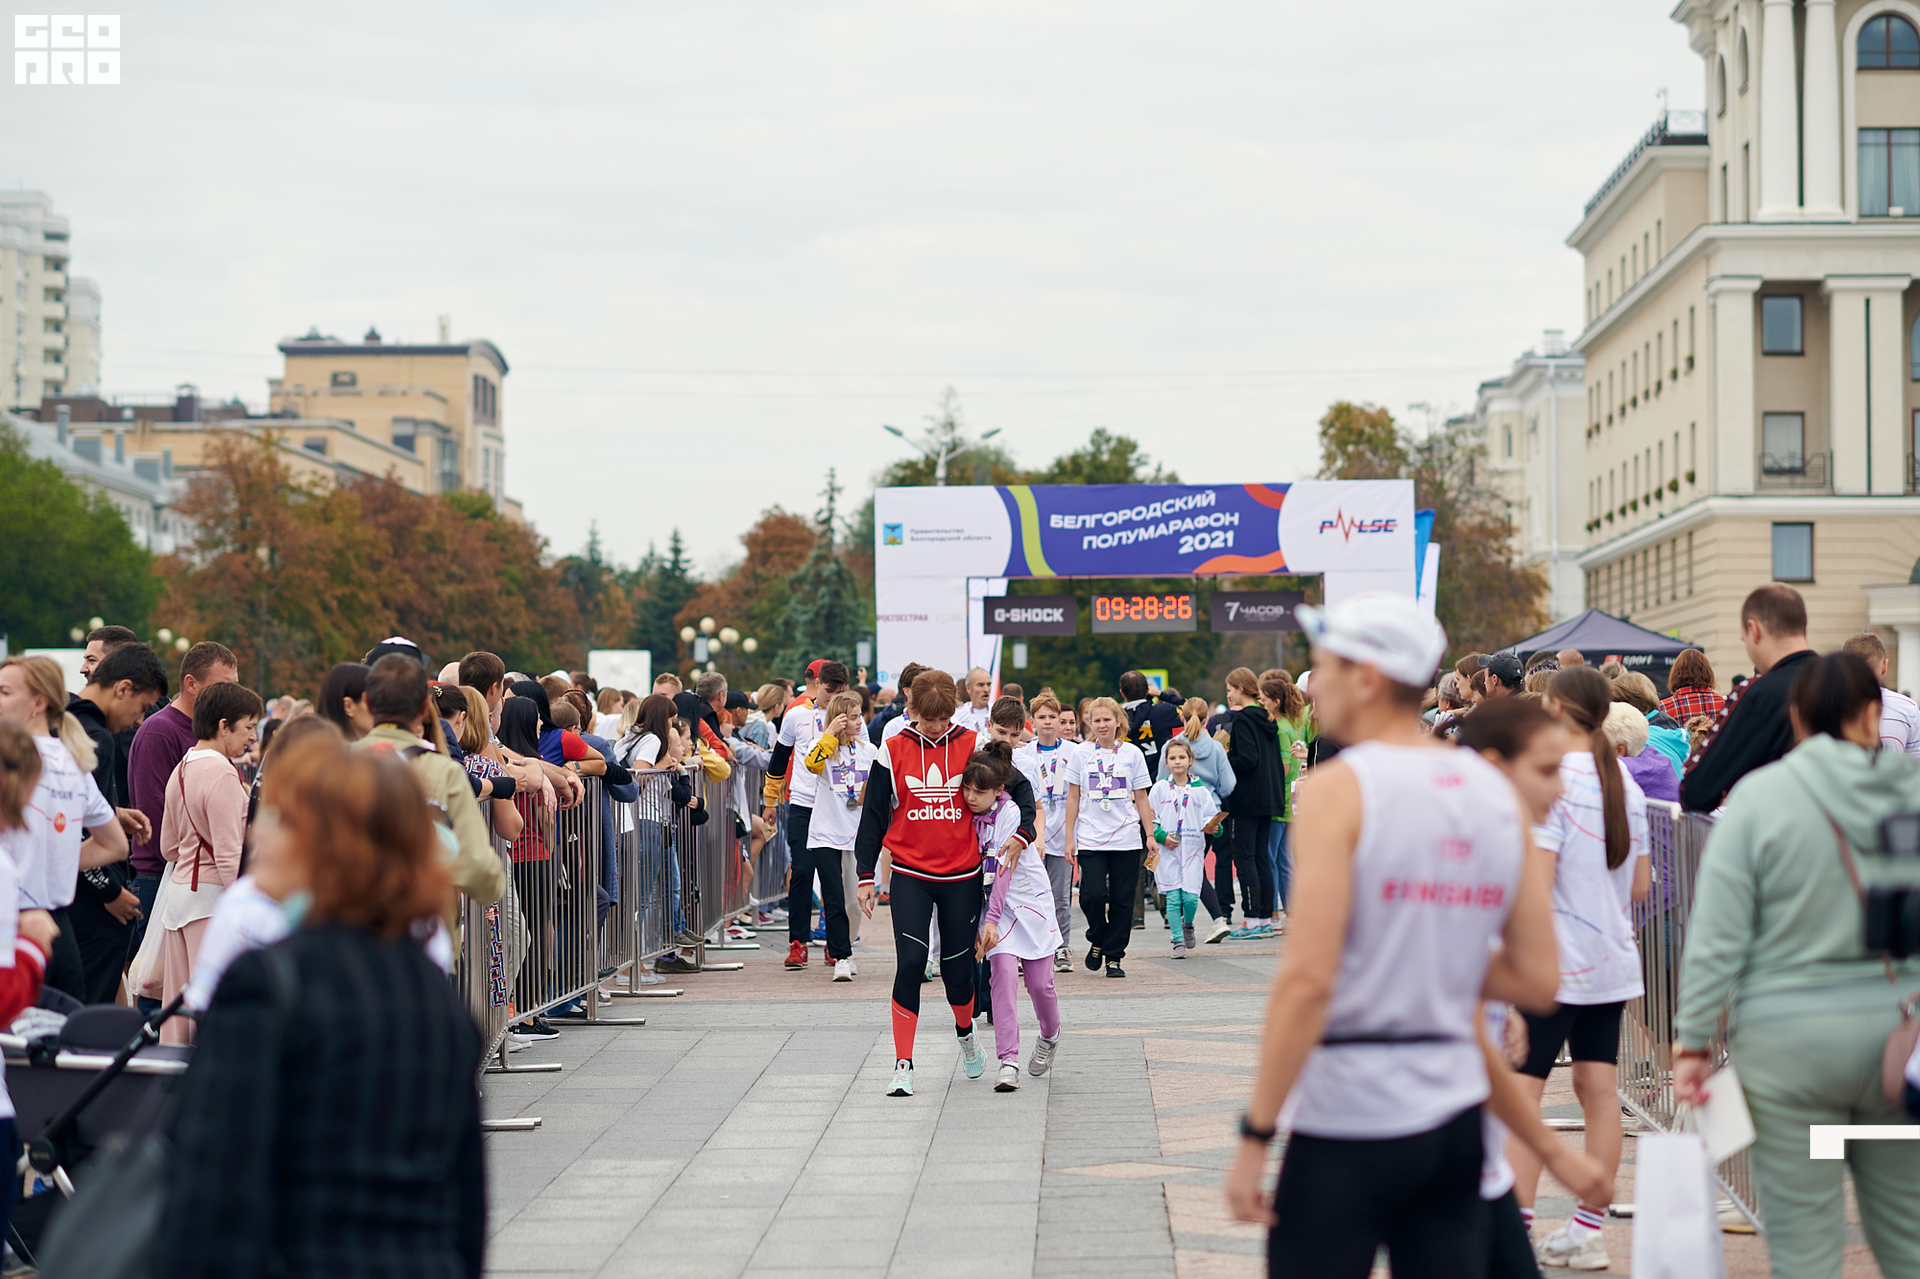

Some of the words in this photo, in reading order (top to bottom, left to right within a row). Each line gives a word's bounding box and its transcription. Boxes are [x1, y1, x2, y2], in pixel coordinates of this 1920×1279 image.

[1050, 490, 1216, 529] БЕЛГОРОДСКИЙ
[1083, 512, 1239, 550] ПОЛУМАРАФОН
[1178, 530, 1234, 555] 2021
[1095, 595, 1193, 621] 09:28:26
[1225, 602, 1240, 622] 7
[1239, 605, 1284, 616] ЧАСОВ
[907, 805, 962, 821] adidas
